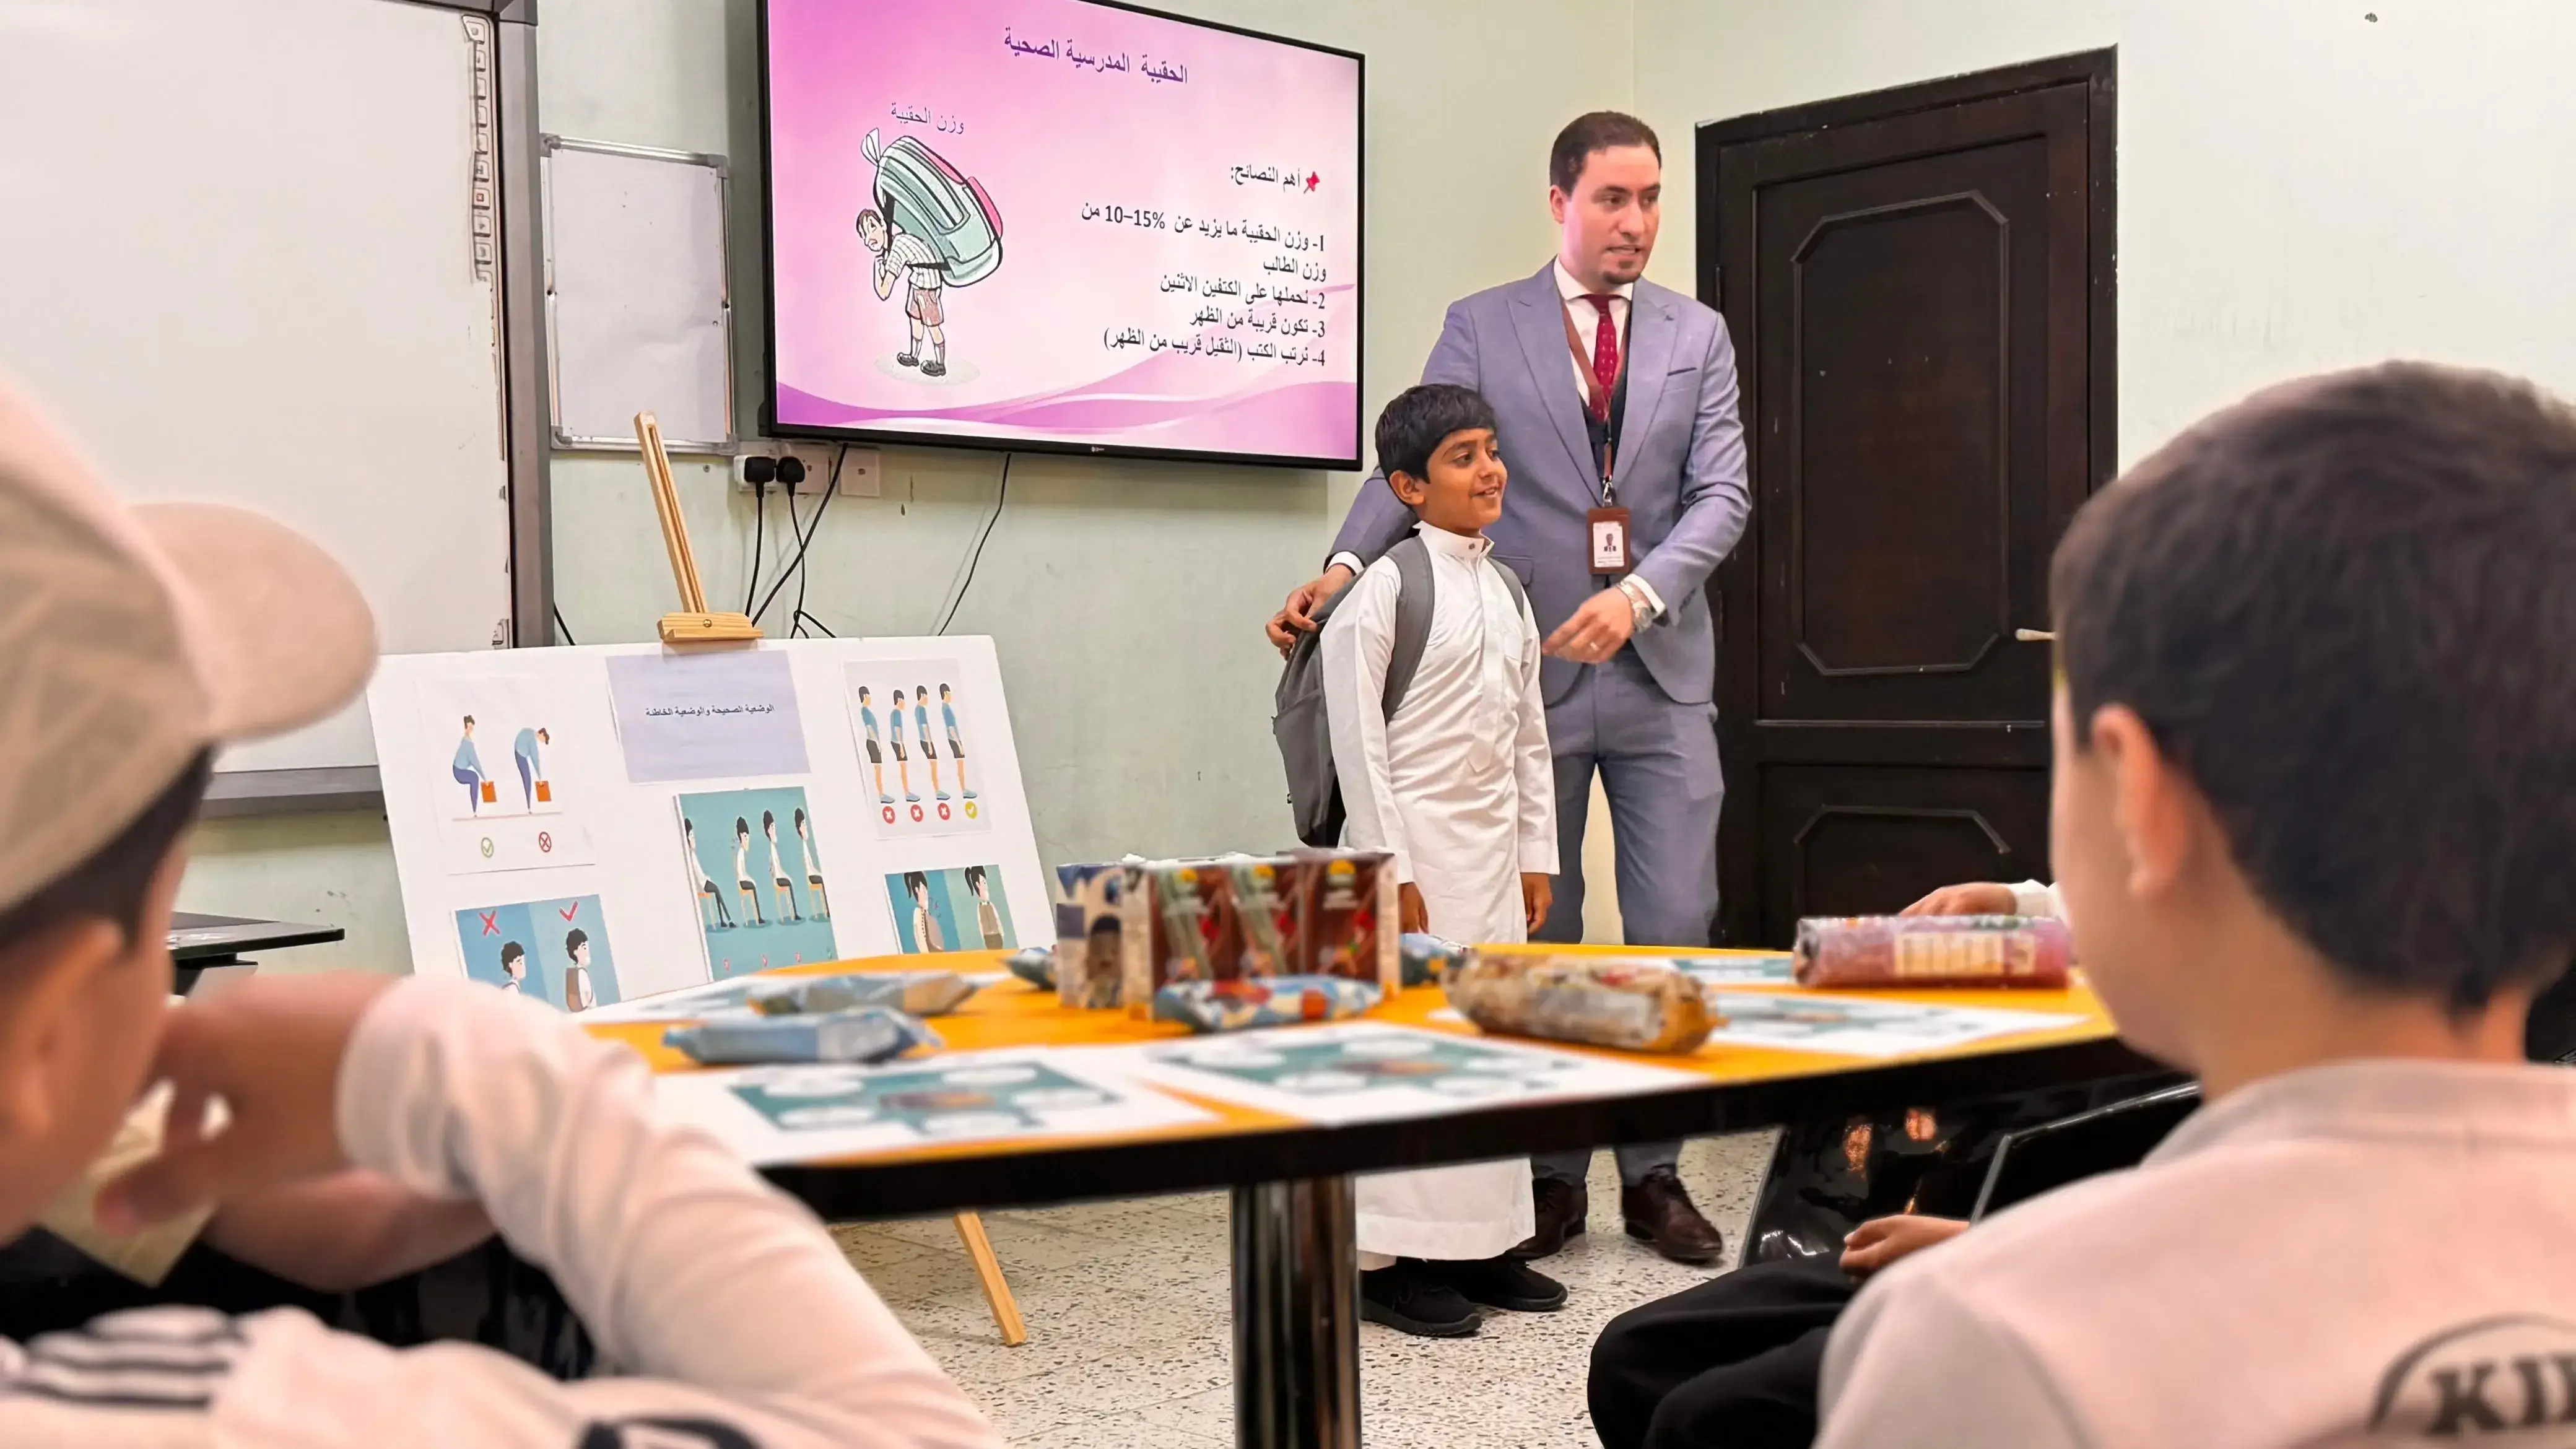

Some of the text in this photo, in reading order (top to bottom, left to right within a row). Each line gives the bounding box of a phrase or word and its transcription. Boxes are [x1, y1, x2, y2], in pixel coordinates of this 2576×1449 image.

[1004, 26, 1188, 84] الحقيبة المدرسية الصحية
[891, 102, 964, 134] وزن الحقيبة
[1230, 163, 1300, 193] أهم النصائح:
[1081, 202, 1100, 220] من
[1174, 215, 1193, 233] عن
[1199, 218, 1222, 238] يزيد
[1226, 220, 1238, 236] ما
[1242, 219, 1281, 243] الحقيبة
[1285, 230, 1309, 251] وزن
[1263, 256, 1326, 282] وزن الطالب
[1160, 272, 1198, 292] الاثنين
[1203, 277, 1241, 297] الكتفين
[1245, 282, 1267, 305] على
[1273, 286, 1308, 307] نحملها
[1190, 305, 1222, 327] الظهر
[1227, 312, 1244, 329] من
[1248, 308, 1277, 334] قريبة
[1281, 318, 1308, 336] تكون
[1103, 327, 1145, 351] الظهر)
[1149, 334, 1167, 352] من
[1172, 334, 1202, 355] قريب
[1206, 336, 1242, 363] (الثقيل
[1247, 342, 1276, 361] الكتب
[1281, 347, 1308, 365] نرتب
[711, 705, 744, 716] الصحيحة
[744, 703, 775, 715] الوضعية
